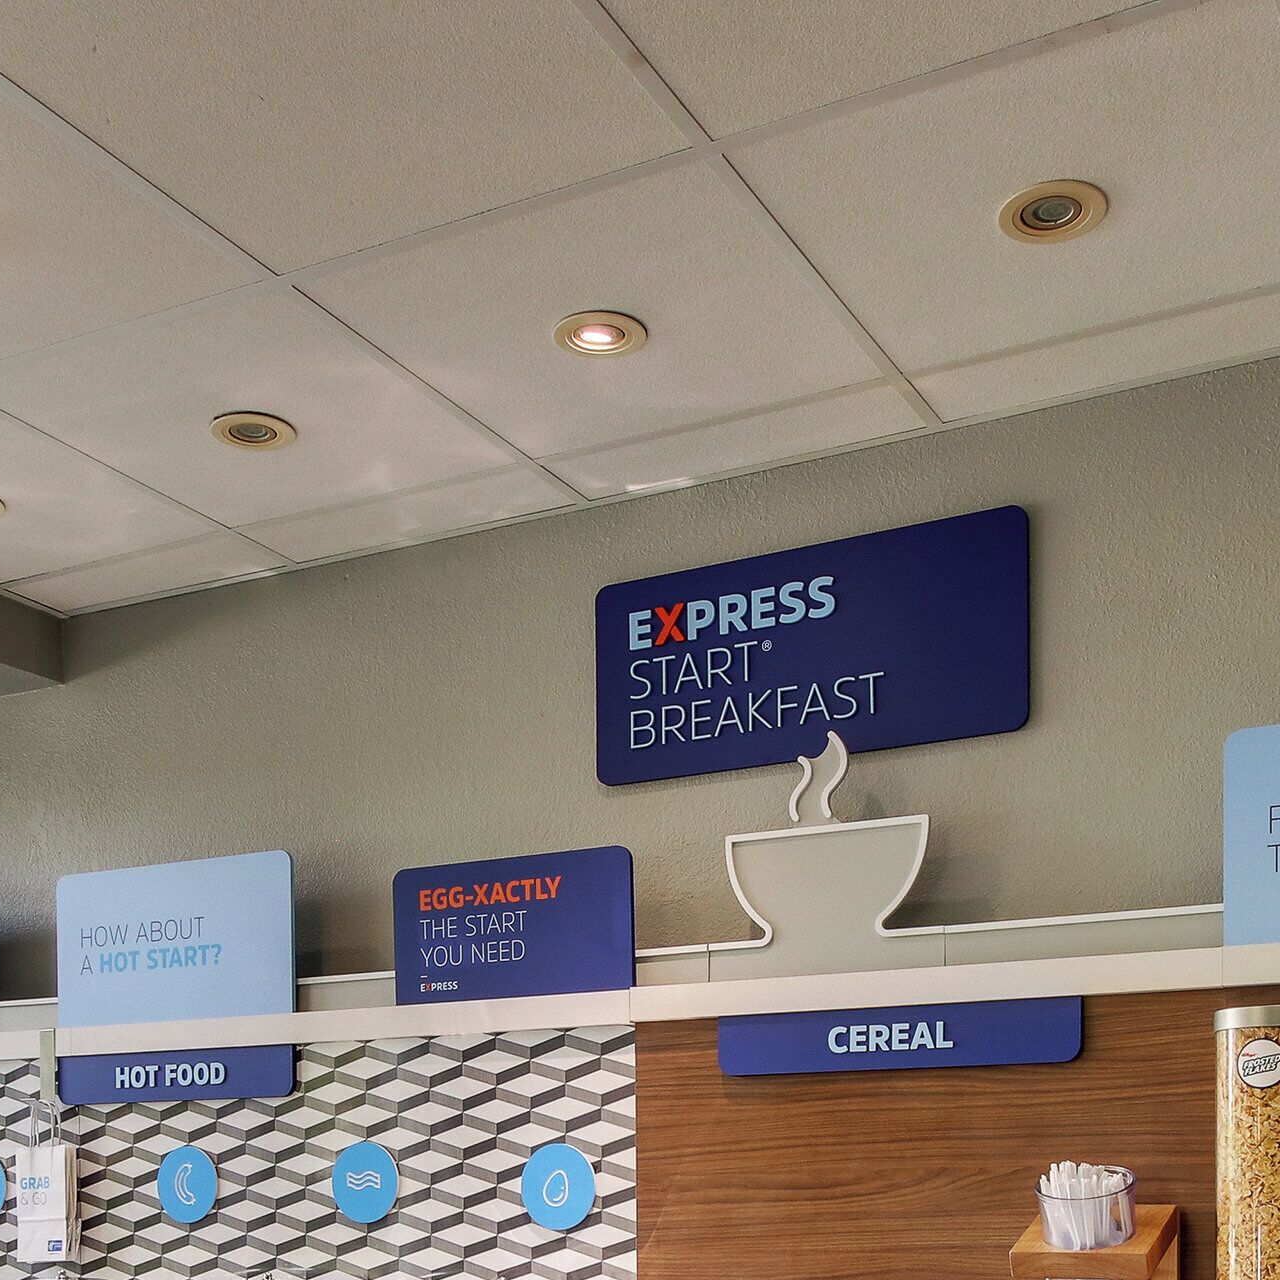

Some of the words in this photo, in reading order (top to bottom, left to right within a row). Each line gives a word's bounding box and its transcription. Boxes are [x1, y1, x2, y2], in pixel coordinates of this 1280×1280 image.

[628, 576, 837, 651] EXPRESS
[629, 671, 885, 750] BREAKFAST
[419, 875, 562, 912] EGG-XACTLY
[80, 924, 129, 949] HOW
[135, 916, 205, 943] ABOUT
[419, 916, 458, 940] THE
[465, 910, 528, 937] START
[80, 954, 94, 976] A
[99, 950, 140, 974] HOT
[146, 943, 223, 970] START?
[420, 943, 463, 968] YOU
[471, 939, 526, 964] NEED
[420, 980, 459, 993] EXPRESS
[826, 1020, 955, 1055] CEREAL
[114, 1065, 159, 1090] HOT
[163, 1062, 227, 1088] FOOD
[1244, 1063, 1277, 1077] FLAKES
[20, 1176, 51, 1190] GRAB
[20, 1193, 29, 1206] &
[32, 1191, 48, 1206] GO
